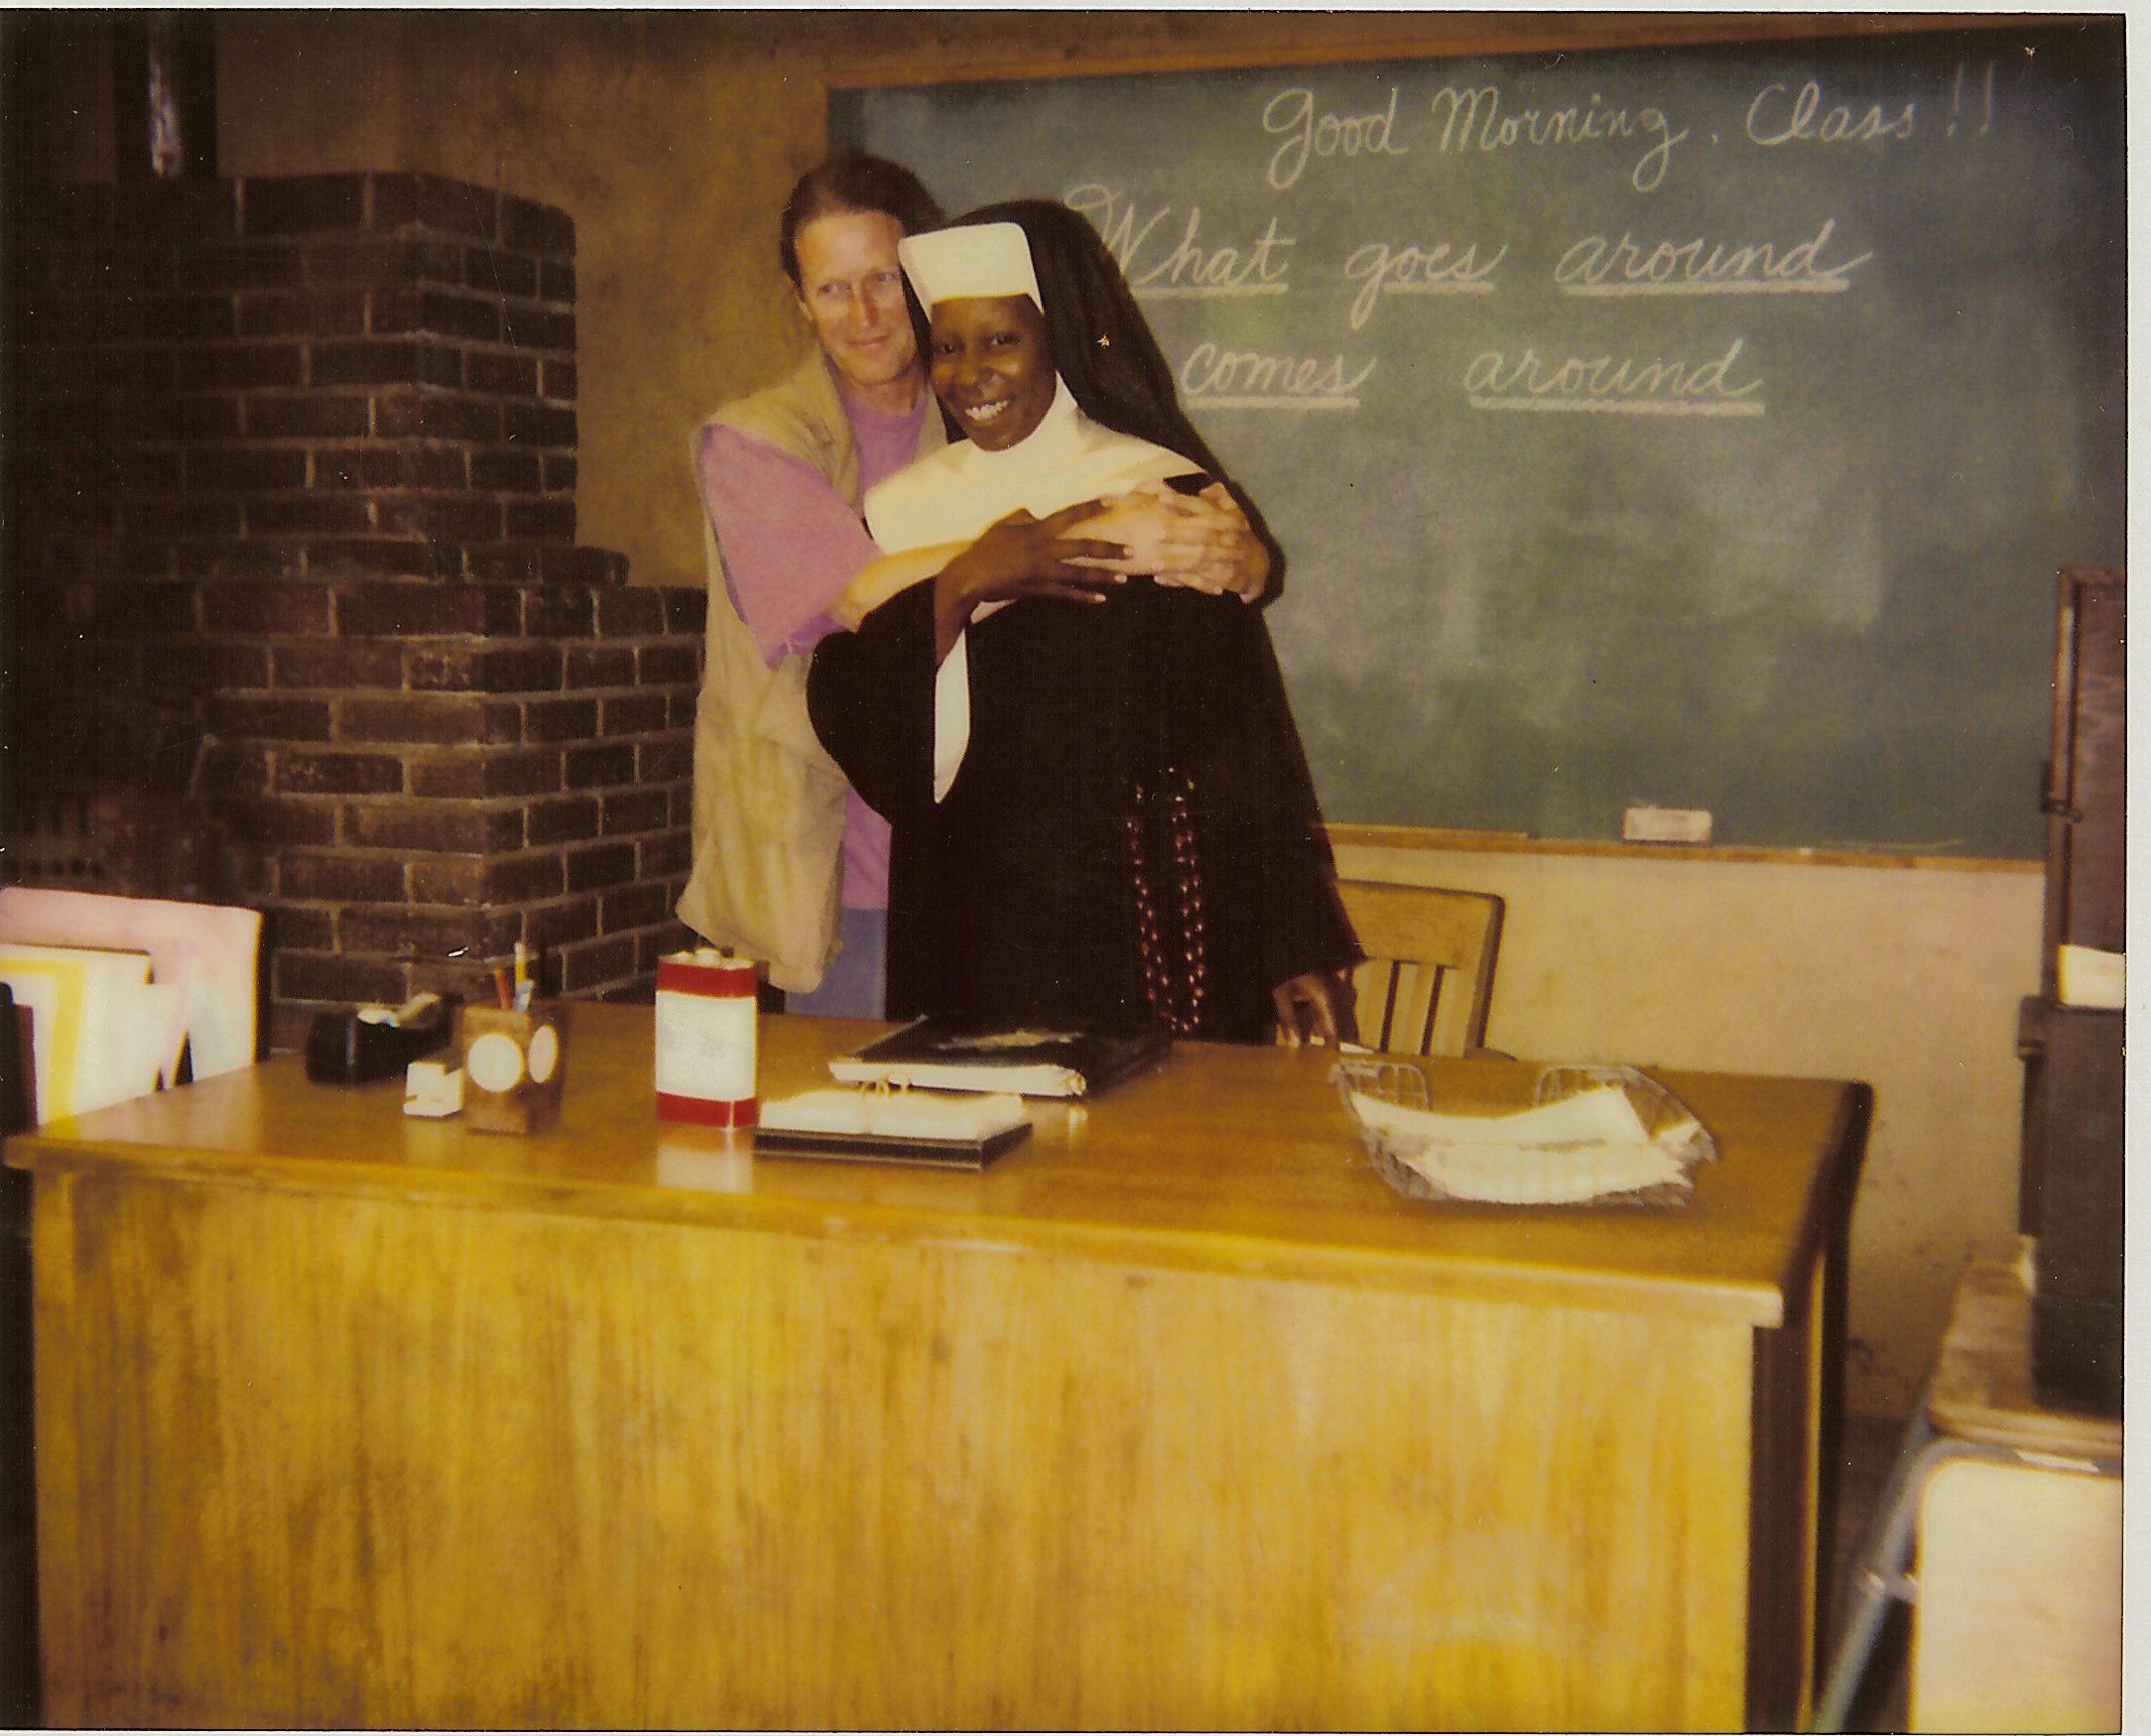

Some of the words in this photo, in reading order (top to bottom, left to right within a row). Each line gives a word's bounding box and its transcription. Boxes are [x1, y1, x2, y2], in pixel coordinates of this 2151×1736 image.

[1064, 184, 1296, 287] What
[1343, 241, 1509, 330] goes
[1554, 217, 1875, 285] around
[1180, 342, 1377, 395] comes
[1462, 337, 1764, 395] around
